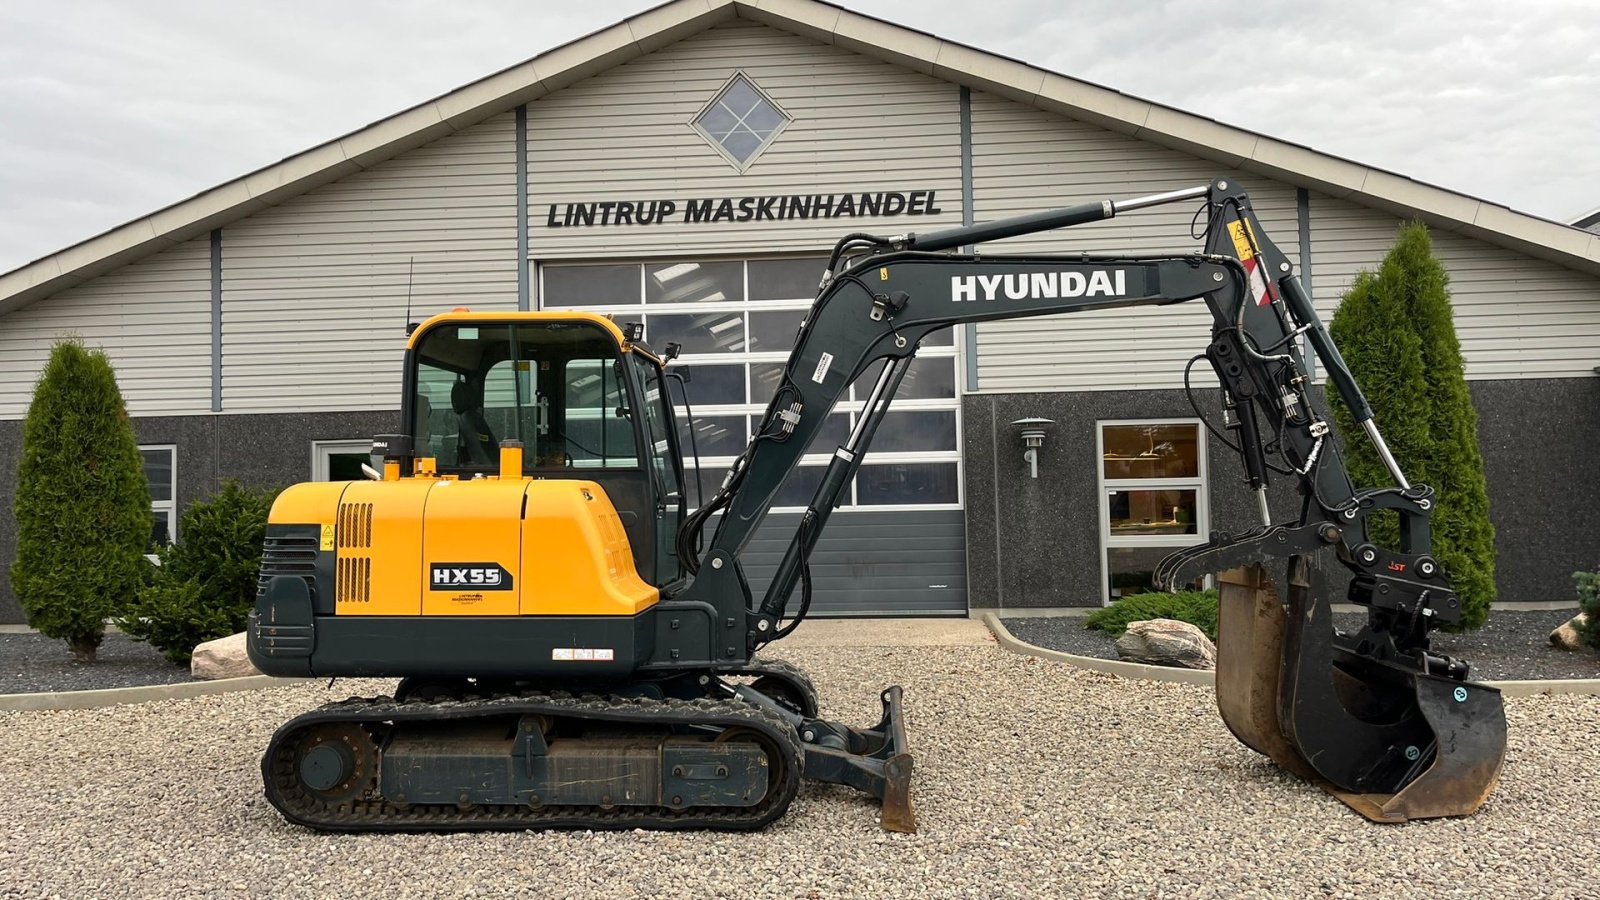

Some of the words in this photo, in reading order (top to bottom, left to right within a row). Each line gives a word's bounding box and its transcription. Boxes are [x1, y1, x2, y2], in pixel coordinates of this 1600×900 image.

[547, 201, 676, 227] LINTRUP
[684, 191, 942, 223] MASKINHANDEL
[951, 270, 1126, 301] HYUNDAI
[433, 569, 500, 583] HX55
